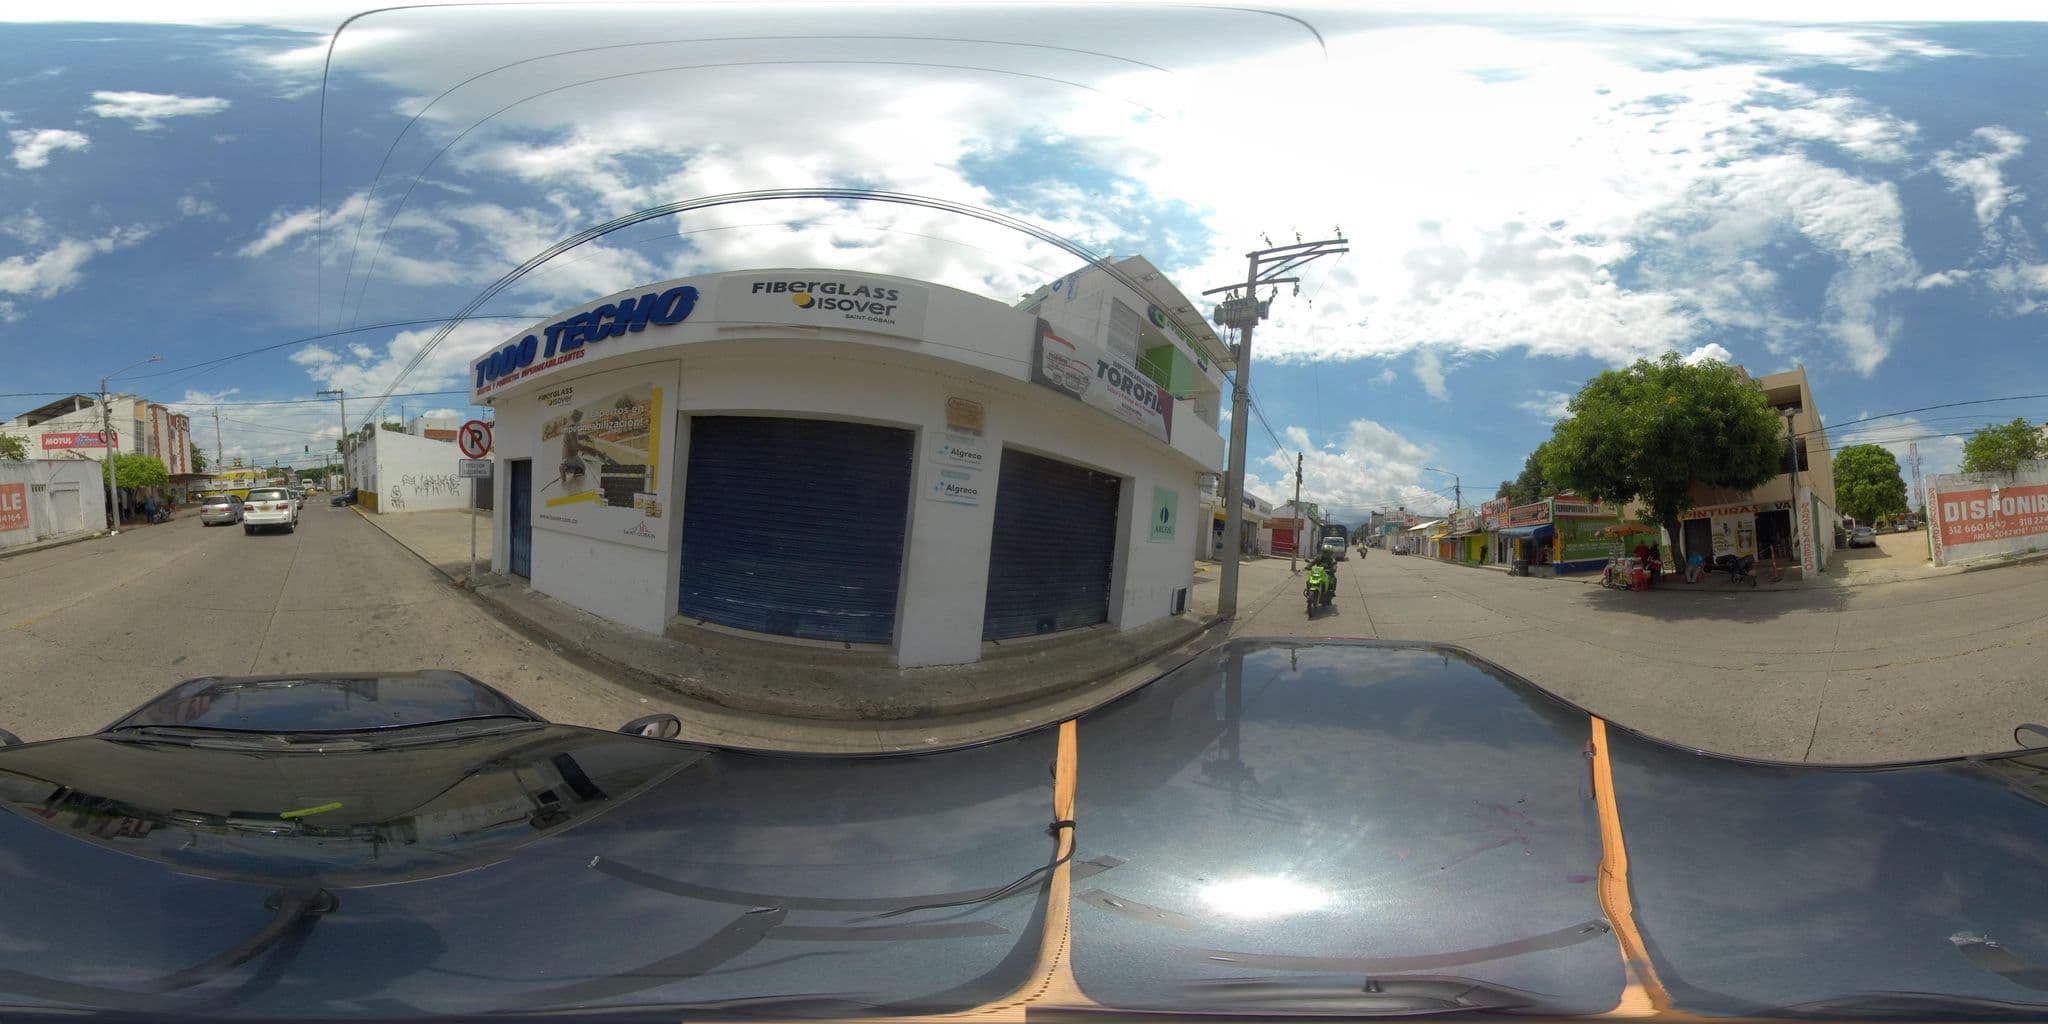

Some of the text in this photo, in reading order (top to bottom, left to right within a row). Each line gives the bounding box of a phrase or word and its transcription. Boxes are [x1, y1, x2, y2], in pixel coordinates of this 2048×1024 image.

[845, 314, 896, 325] SAINT-GOBAIN
[475, 285, 700, 389] TODO TECHO
[44, 437, 73, 445] MOTUL
[950, 447, 983, 461] Algreco
[946, 484, 978, 495] Algreco
[1948, 525, 1962, 535] 312
[1965, 523, 1984, 533] 660
